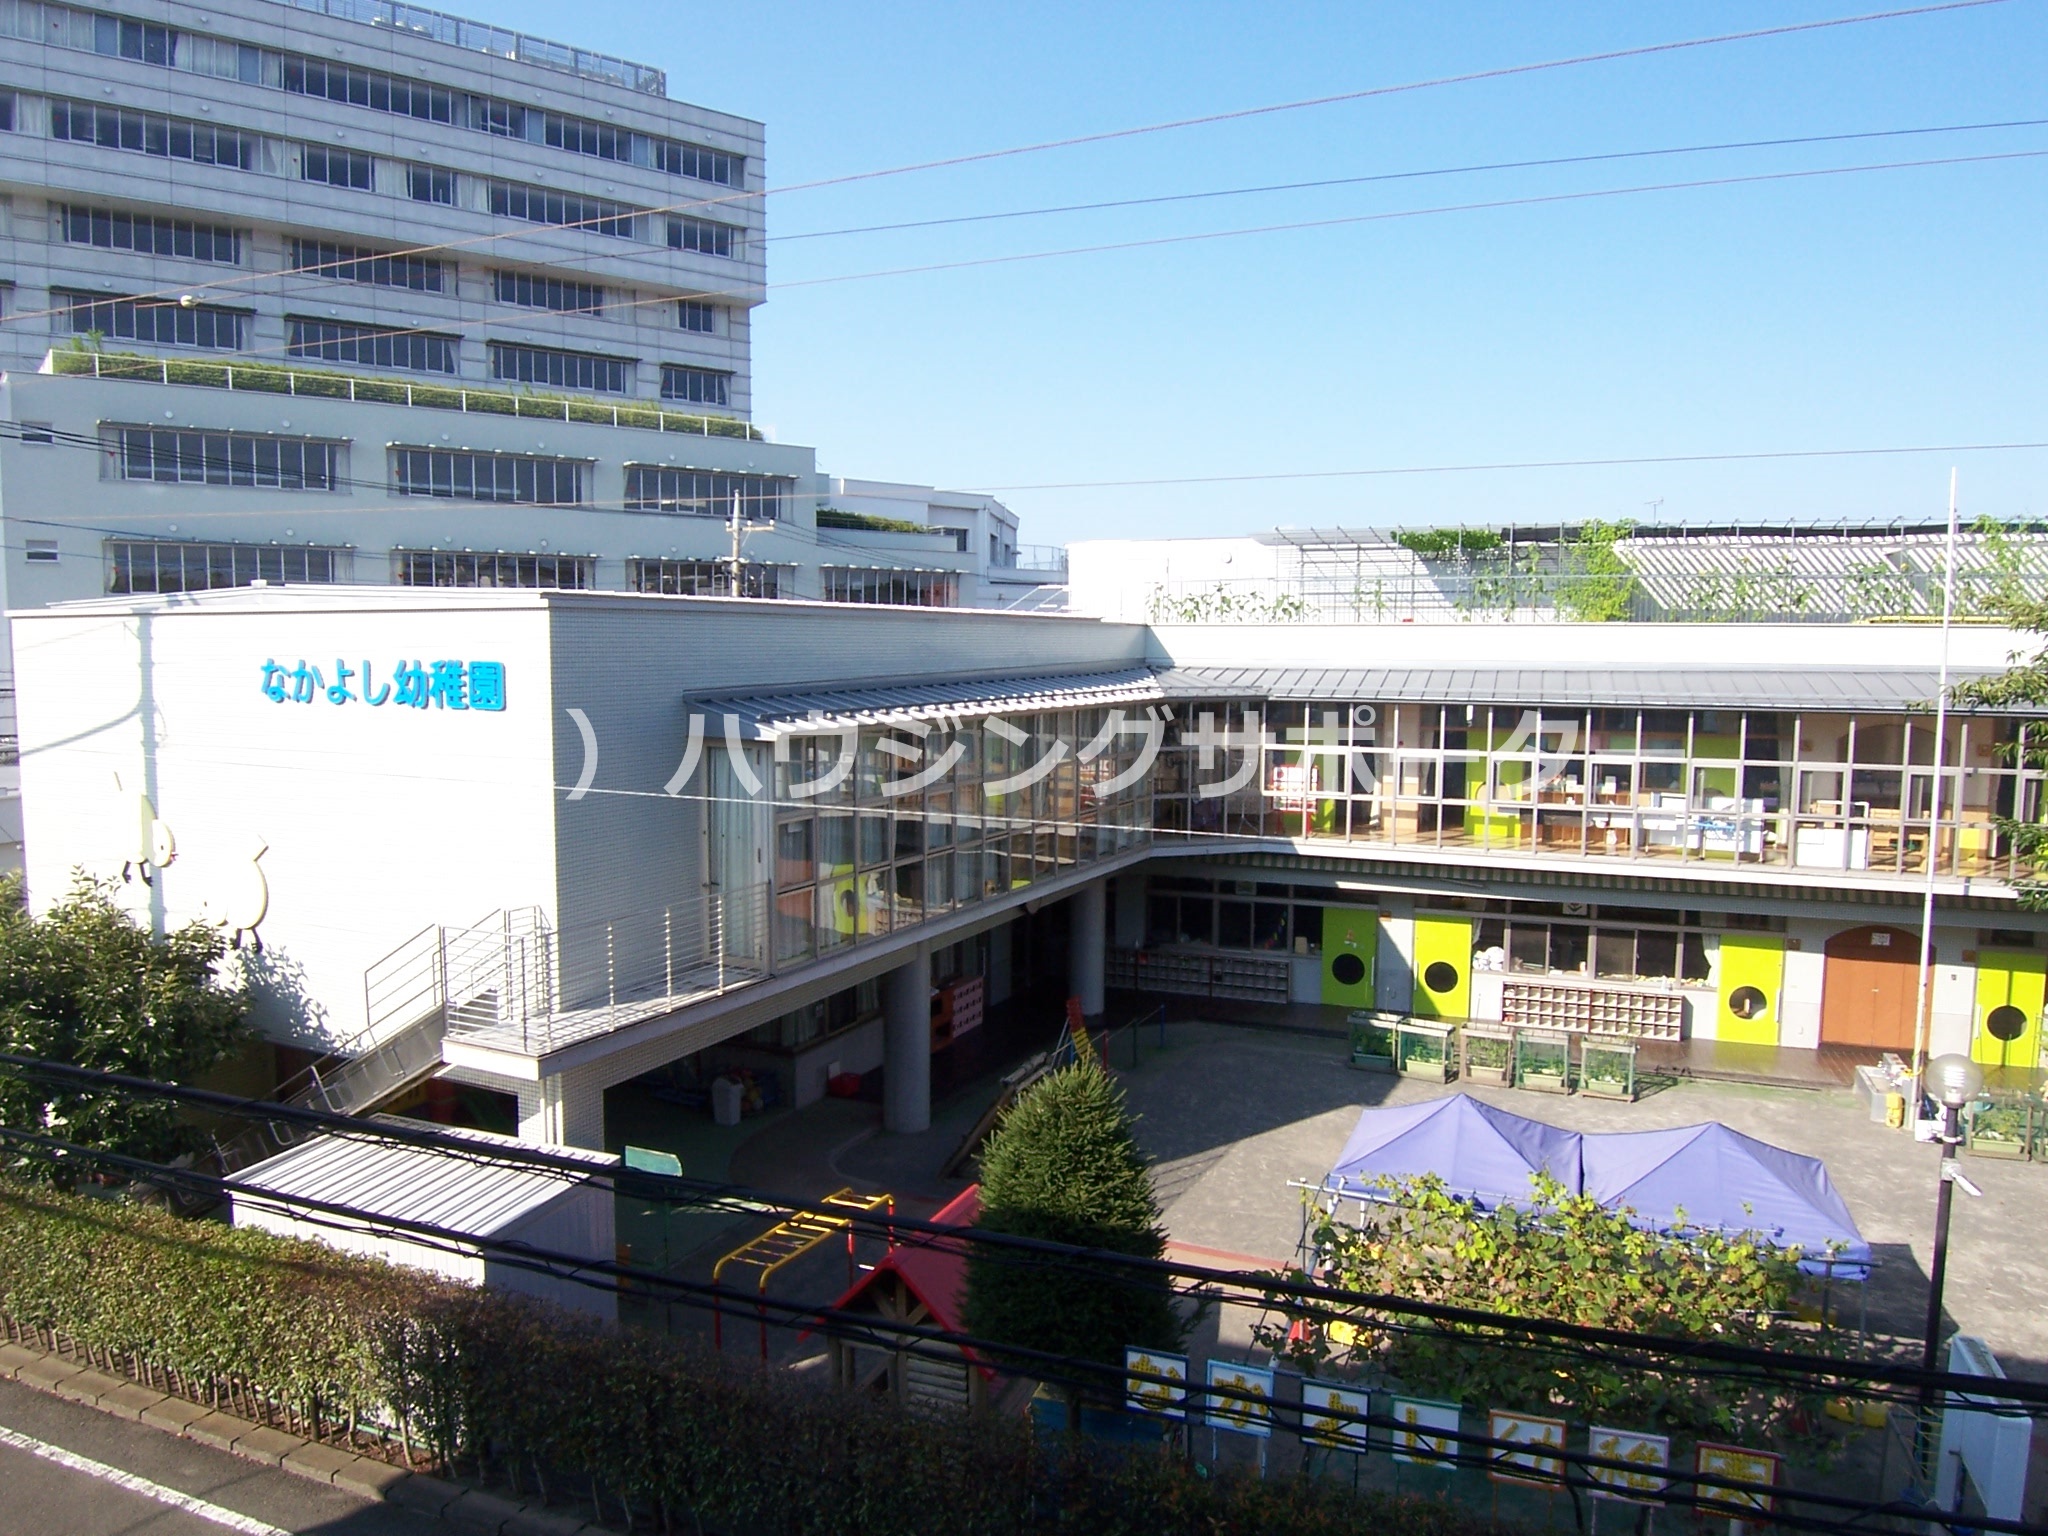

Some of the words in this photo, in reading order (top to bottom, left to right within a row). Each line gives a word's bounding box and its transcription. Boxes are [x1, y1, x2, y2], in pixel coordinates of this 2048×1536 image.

[261, 658, 506, 711] なかよし幼稚園
